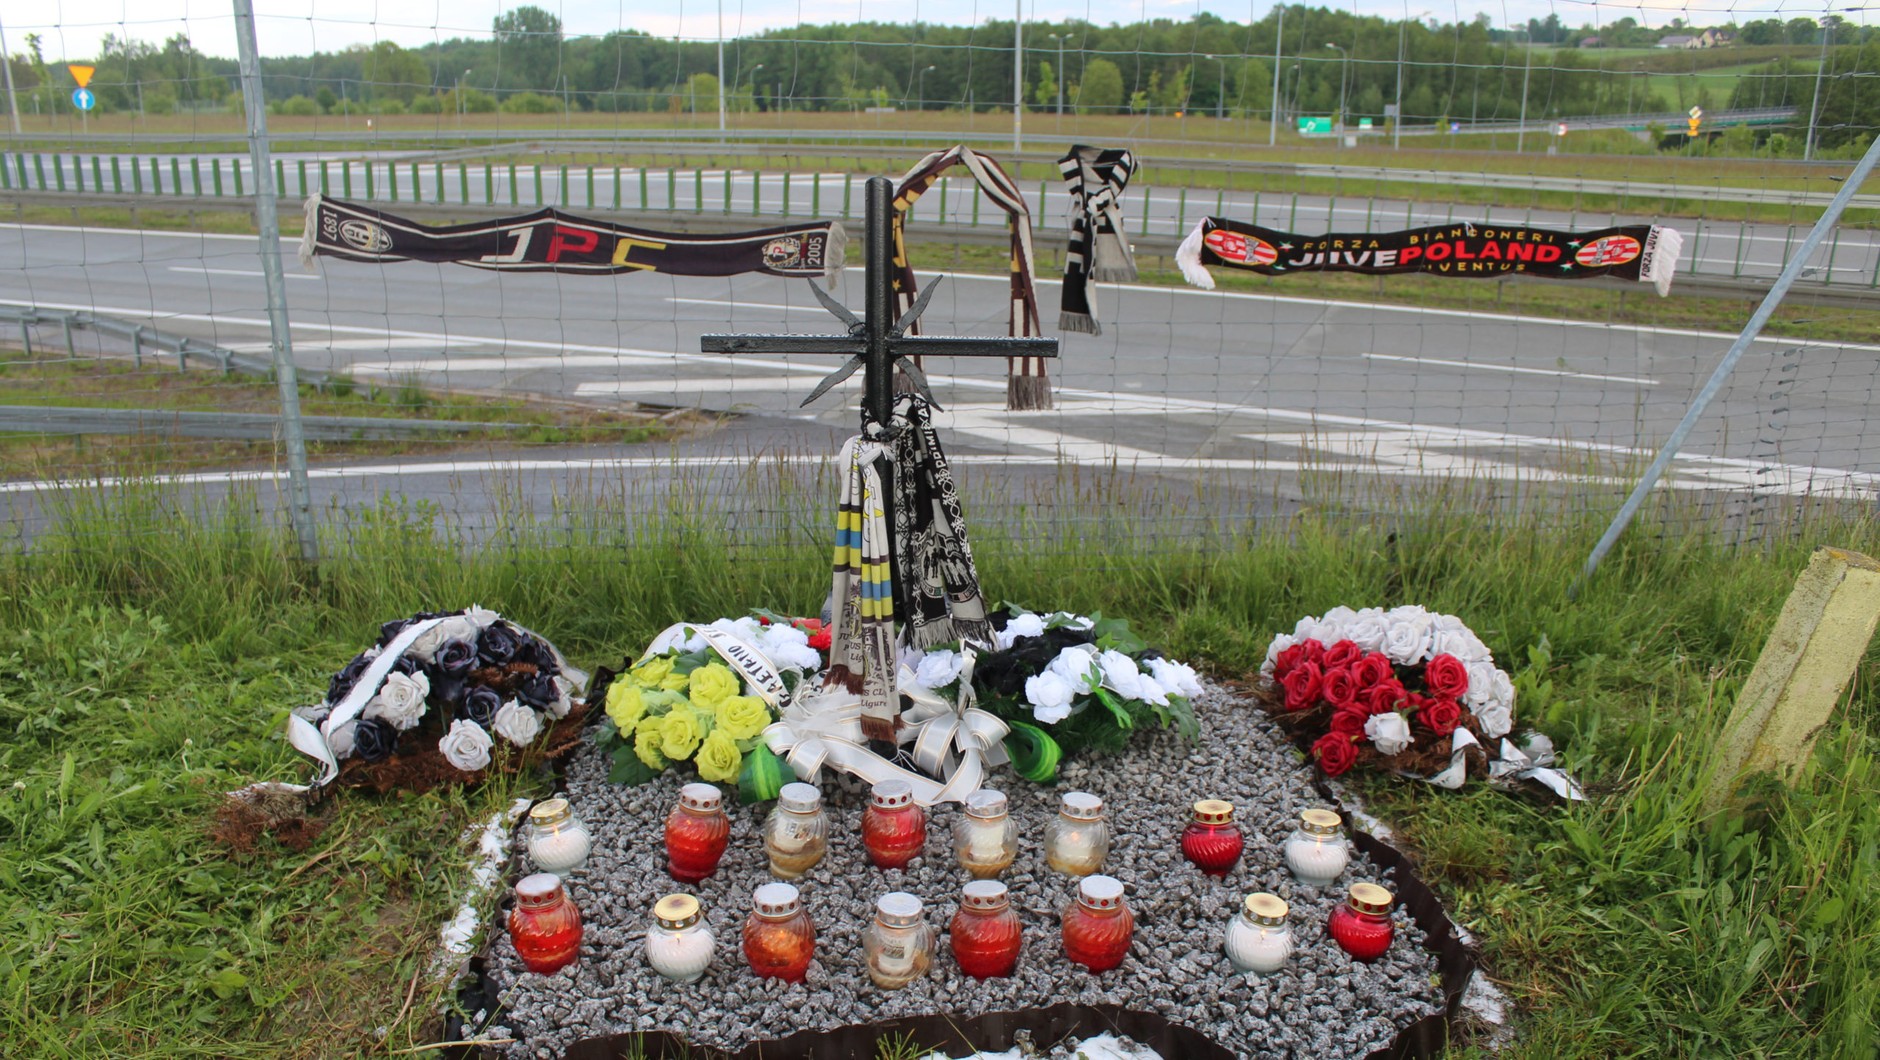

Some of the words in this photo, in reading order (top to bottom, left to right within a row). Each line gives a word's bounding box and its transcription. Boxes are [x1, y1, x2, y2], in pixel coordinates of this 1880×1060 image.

[322, 209, 338, 242] 1897
[1302, 239, 1379, 250] FORZA
[1409, 228, 1555, 245] BIANCONERI
[1646, 228, 1660, 250] JUVE
[807, 236, 823, 265] 2005
[1640, 252, 1654, 278] FORZA
[727, 644, 793, 708] GAETANO
